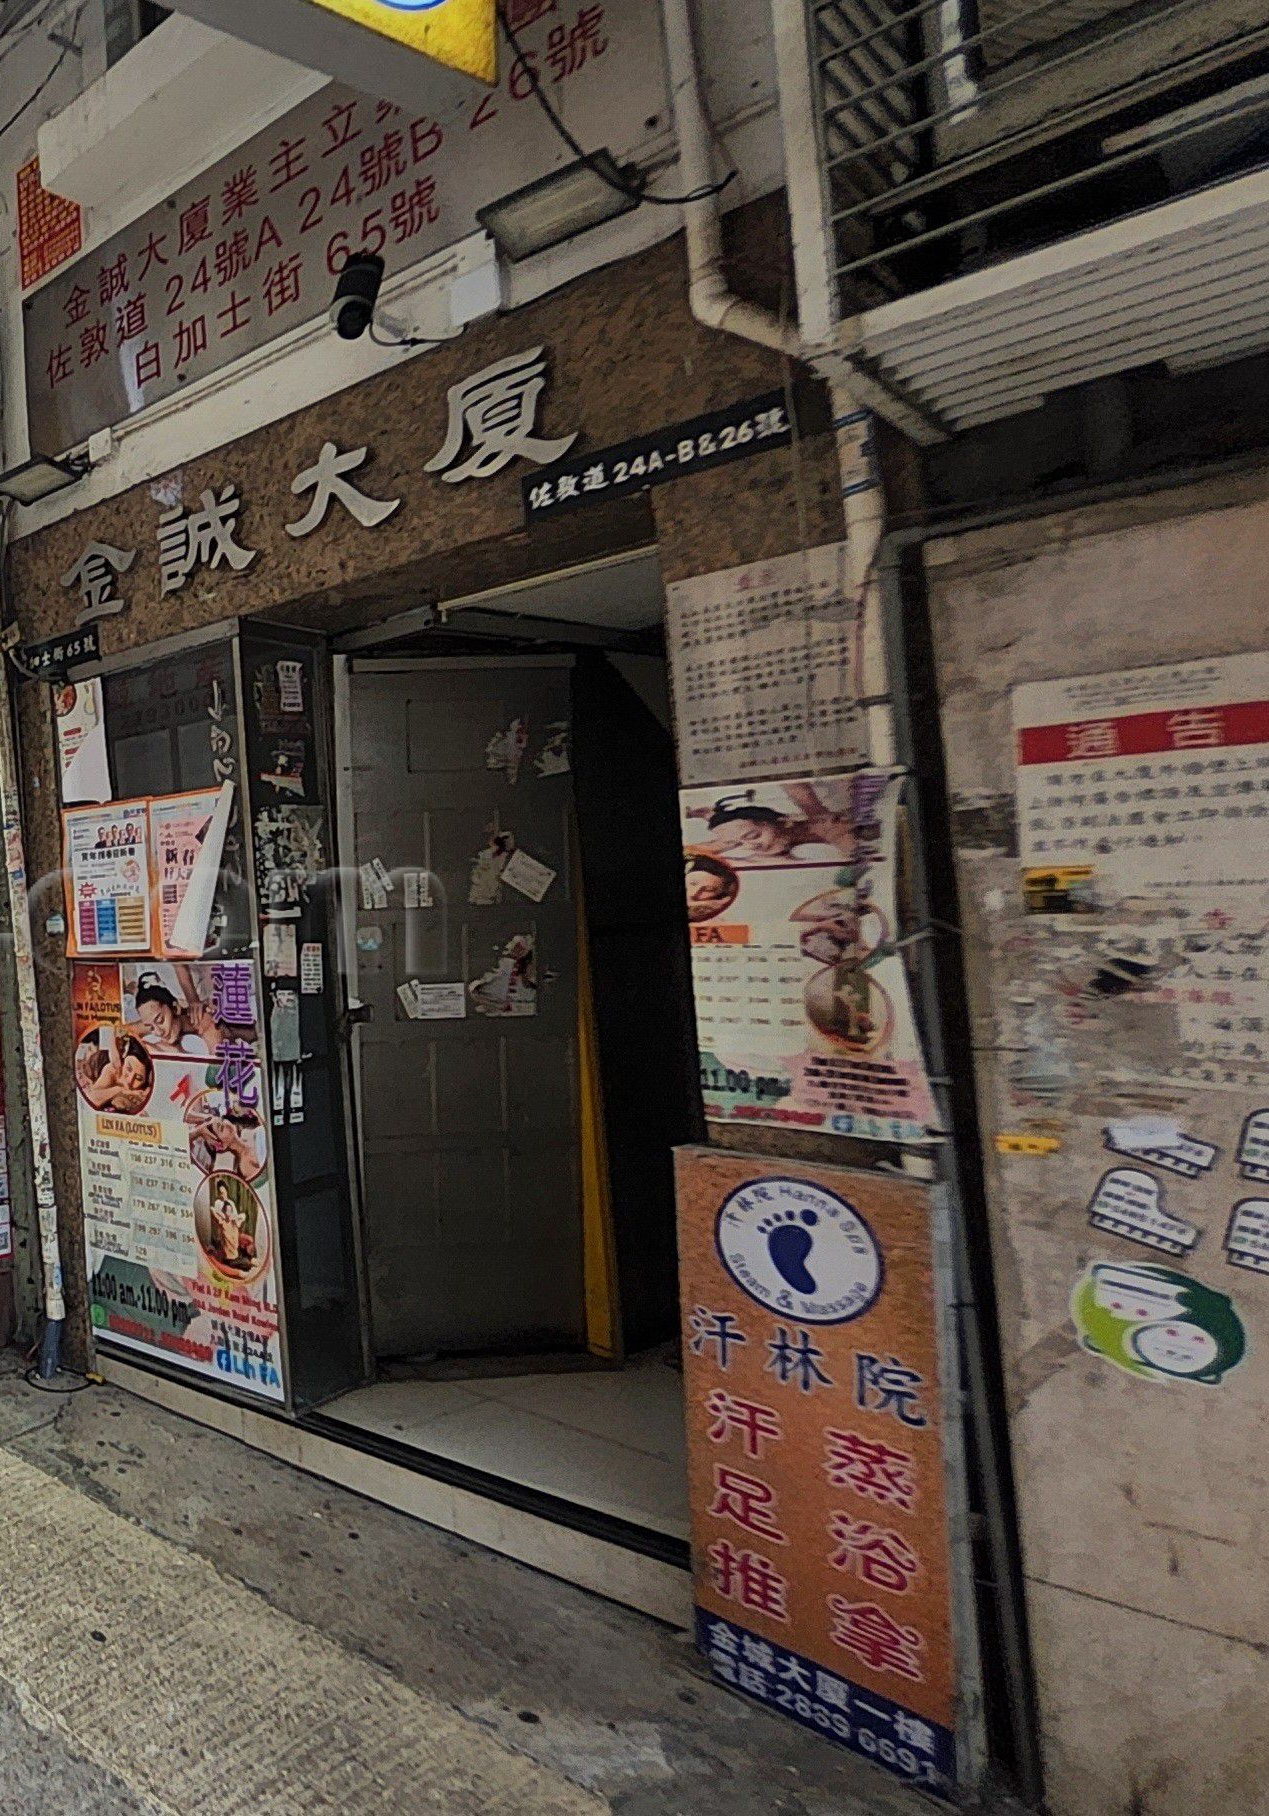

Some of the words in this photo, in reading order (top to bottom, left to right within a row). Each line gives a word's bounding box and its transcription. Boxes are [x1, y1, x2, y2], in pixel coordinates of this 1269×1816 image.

[46, 292, 149, 389] 佐敦道
[166, 221, 283, 317] 24號A
[298, 118, 444, 232] 24號B
[62, 100, 400, 330] 金誠大廈業主立
[134, 252, 304, 389] 白加士街
[327, 180, 441, 276] 65號
[60, 345, 578, 625] 金誠大廈
[210, 963, 259, 1113] 蓮花
[689, 1303, 929, 1428] 汗林院
[775, 1288, 794, 1310] &
